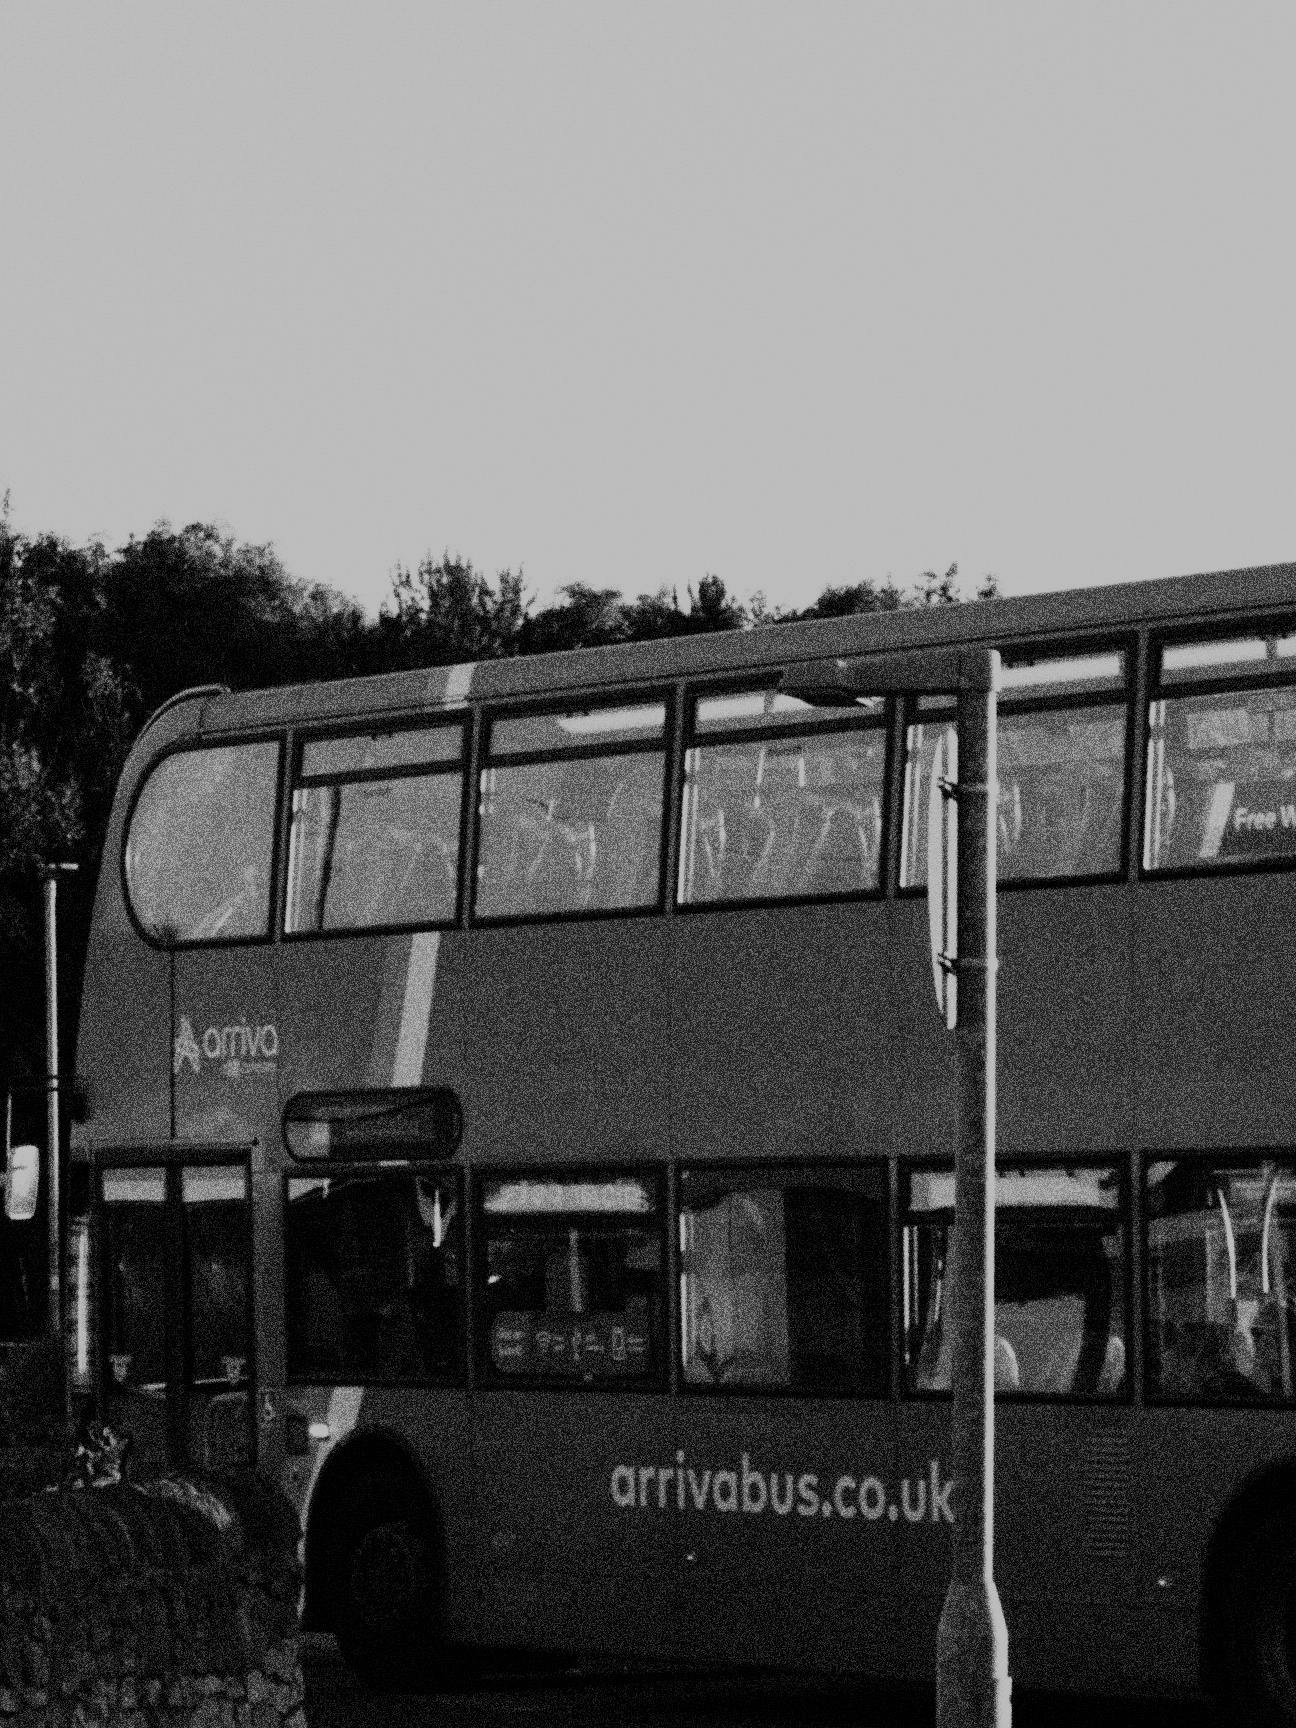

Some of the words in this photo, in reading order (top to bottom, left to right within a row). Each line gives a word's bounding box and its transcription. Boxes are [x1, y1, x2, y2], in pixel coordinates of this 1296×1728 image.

[1233, 807, 1277, 832] Free
[203, 1016, 278, 1059] arriva
[610, 1449, 956, 1523] arrivabus.co.uk
